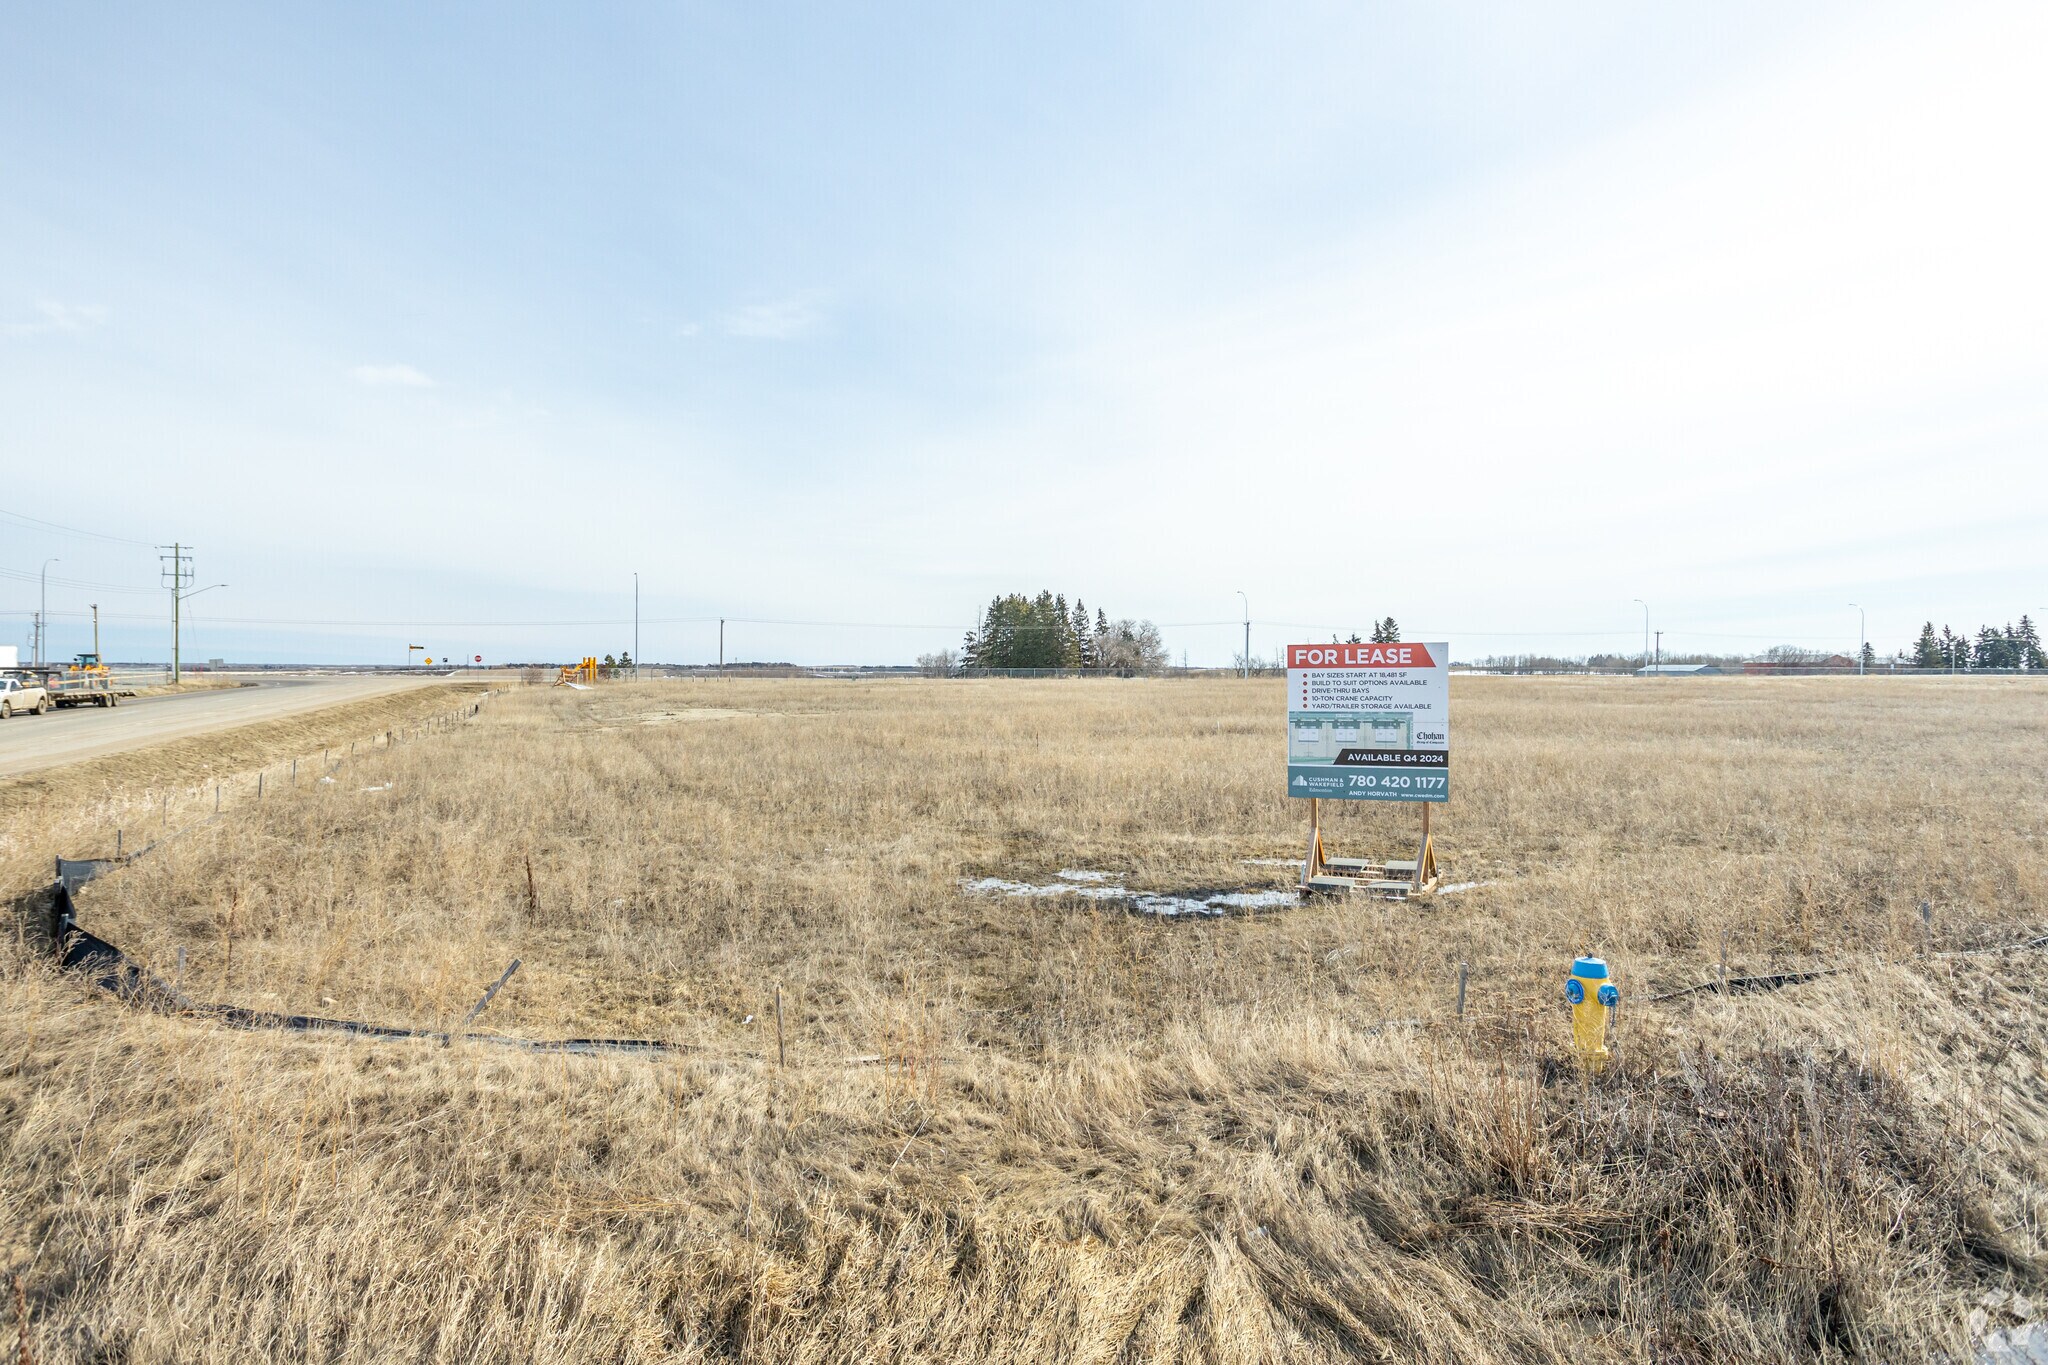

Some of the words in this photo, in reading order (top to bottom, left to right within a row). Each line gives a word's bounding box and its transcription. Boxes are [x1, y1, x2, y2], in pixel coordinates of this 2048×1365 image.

[1295, 649, 1338, 665] FOR
[1344, 648, 1412, 664] LEASE
[1416, 732, 1444, 740] Chohan
[1348, 754, 1401, 762] AVAILABLE
[1404, 754, 1418, 763] Q4
[1419, 754, 1444, 763] 2024
[1348, 775, 1376, 787] 780
[1381, 776, 1410, 788] 420
[1415, 776, 1446, 789] 1177
